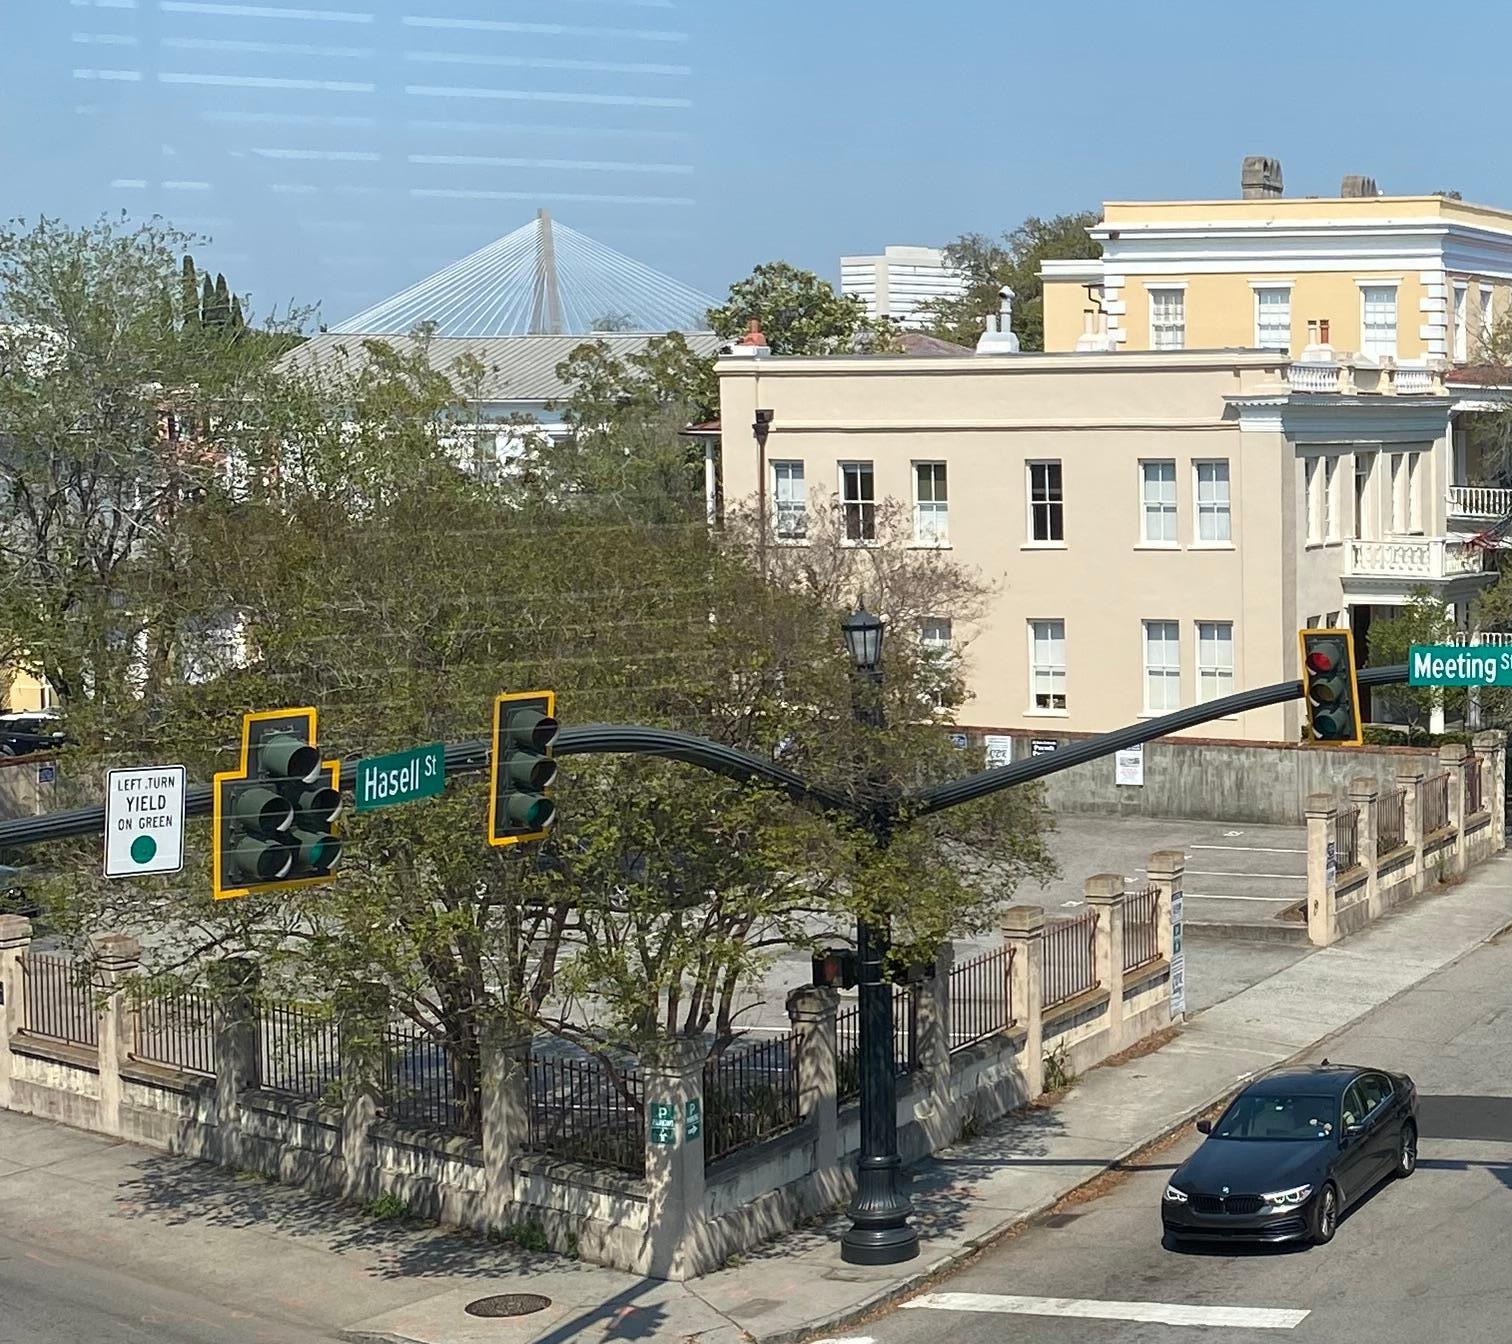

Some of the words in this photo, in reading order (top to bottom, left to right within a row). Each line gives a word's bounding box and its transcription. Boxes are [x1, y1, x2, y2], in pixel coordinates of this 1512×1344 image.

[1414, 652, 1497, 683] Meeting
[118, 777, 142, 792] LEFT
[148, 776, 175, 789] TURN
[365, 758, 420, 802] Hasell
[424, 754, 437, 776] St
[126, 794, 166, 812] YIELD
[118, 817, 132, 831] ON
[138, 815, 173, 829] GREEN
[658, 1107, 668, 1119] P
